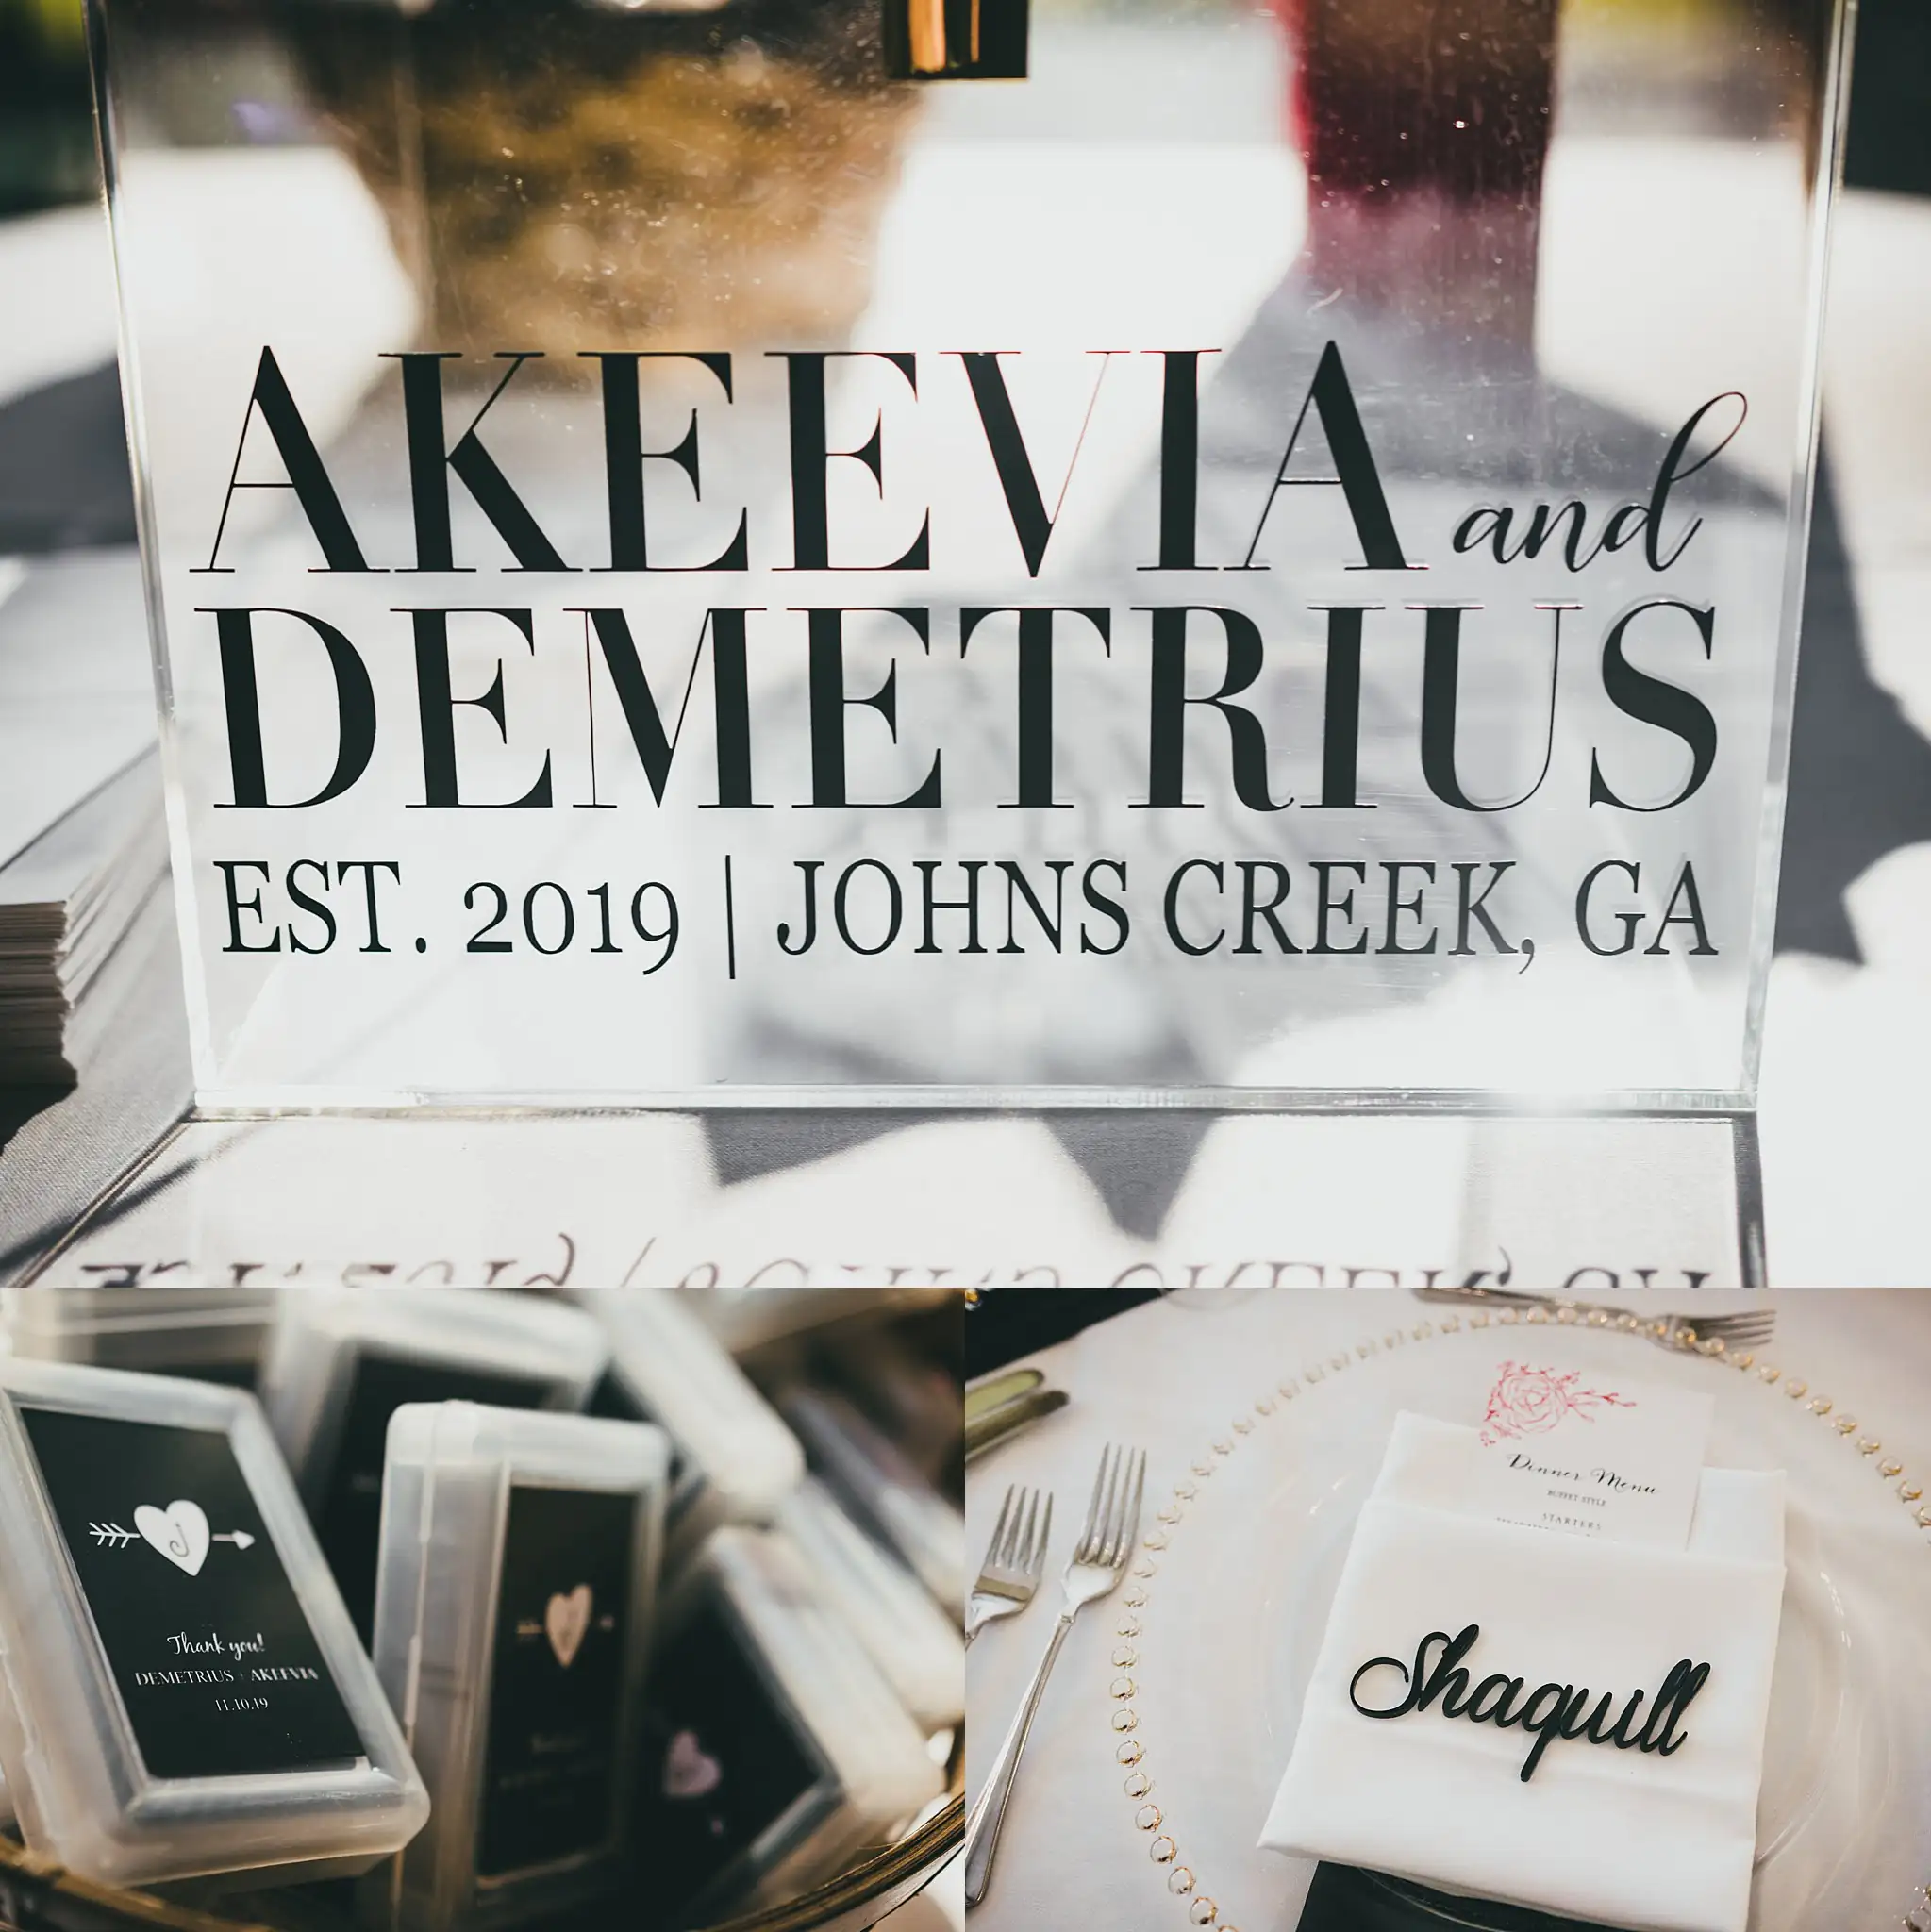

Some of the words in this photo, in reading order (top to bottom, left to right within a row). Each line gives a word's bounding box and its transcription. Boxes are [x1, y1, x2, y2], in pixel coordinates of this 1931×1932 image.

[189, 340, 1430, 577] AKEEVIA
[1452, 391, 1749, 574] and
[193, 600, 1719, 813] DEMETRIUS
[213, 858, 429, 955] EST.
[462, 881, 681, 975] 2019
[775, 858, 1130, 957] JOHNS
[1163, 858, 1535, 975] CREEK,
[1574, 858, 1720, 957] GA
[1507, 1453, 1583, 1481] Dinner
[1590, 1468, 1660, 1494] Menu
[1542, 1512, 1602, 1530] STARTERS
[166, 1631, 225, 1655] Thank
[229, 1632, 266, 1661] you!
[135, 1669, 235, 1686] DEMETRIUS
[250, 1667, 319, 1681] AKEEVIA
[215, 1697, 269, 1712] 11.10.19
[1350, 1624, 1711, 1782] Shaquill
